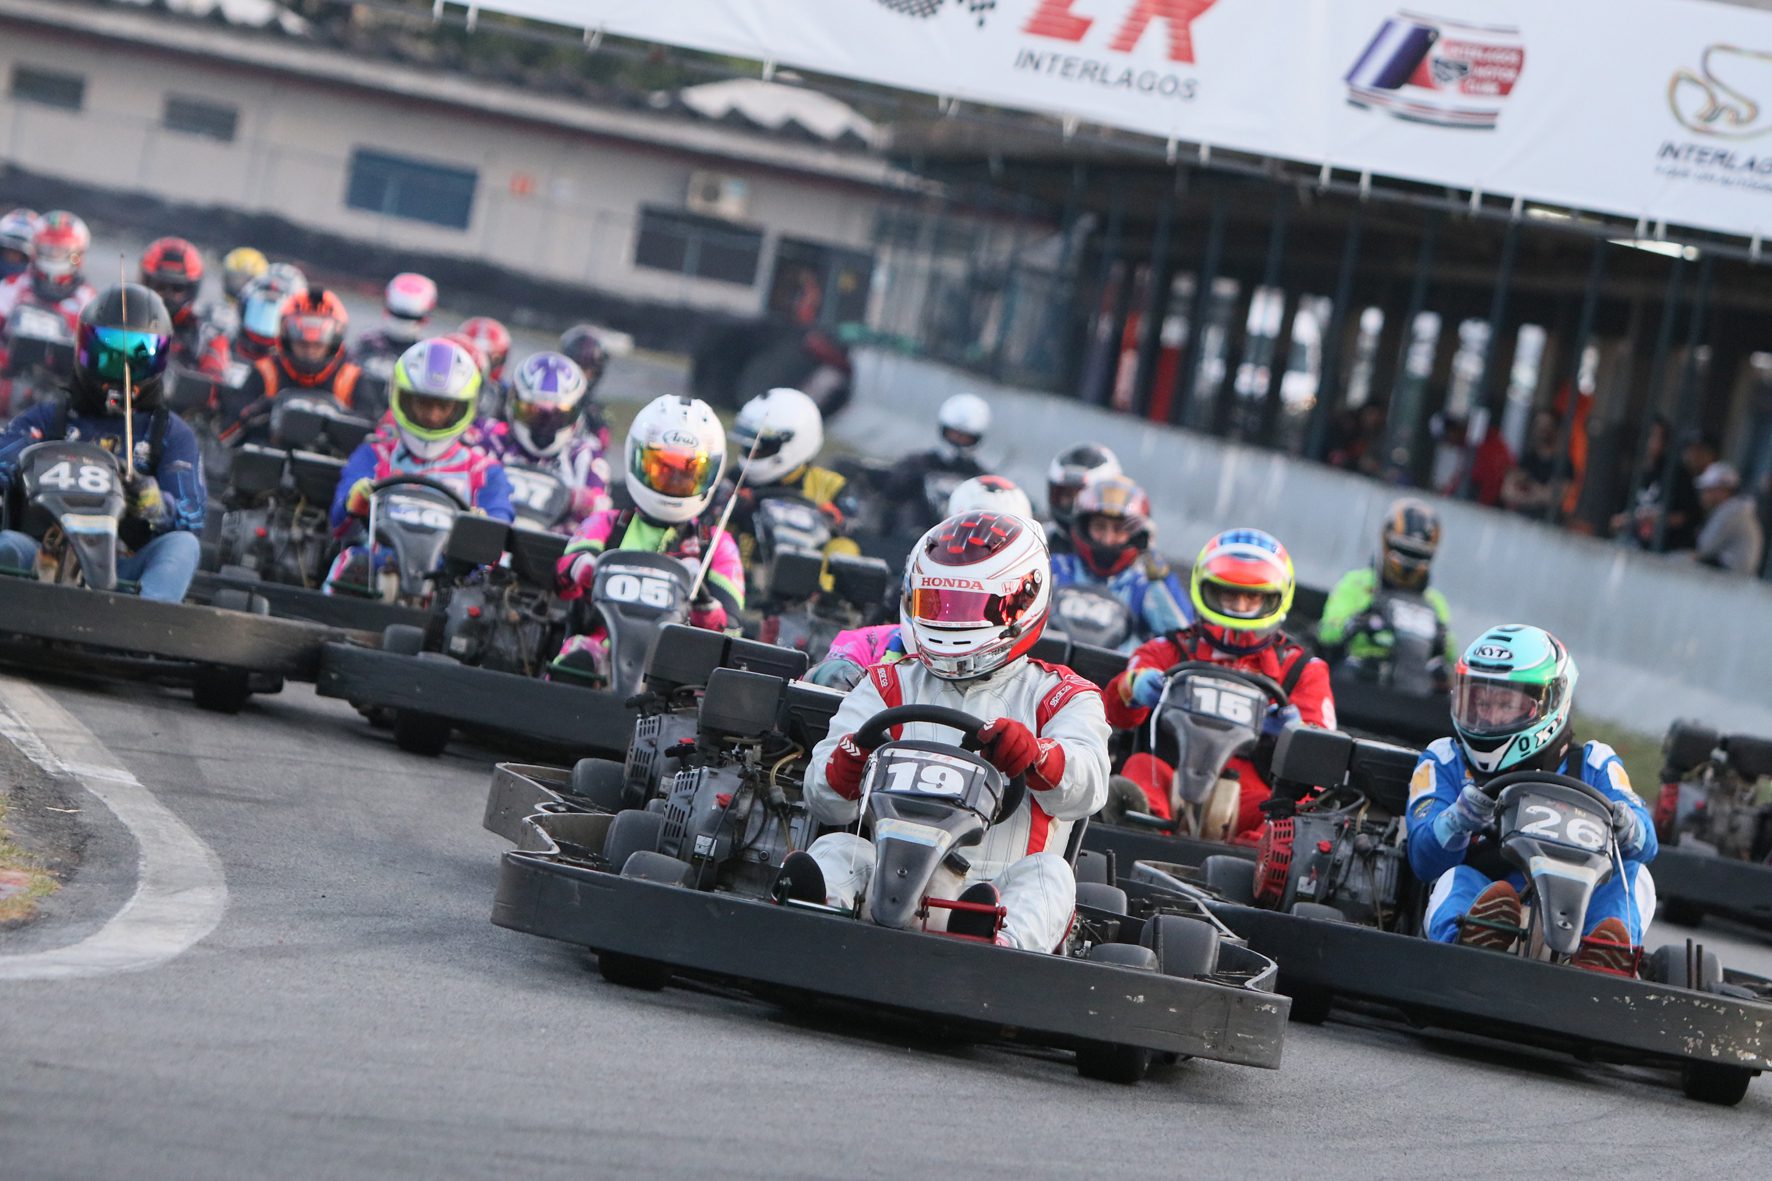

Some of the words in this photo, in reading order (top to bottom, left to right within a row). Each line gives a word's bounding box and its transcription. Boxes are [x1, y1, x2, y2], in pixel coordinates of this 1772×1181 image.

[1014, 49, 1199, 100] INTERLAGOS
[39, 461, 111, 493] 48
[605, 574, 674, 610] 05
[921, 577, 985, 591] HONDA
[1477, 646, 1509, 658] KYT
[1193, 687, 1253, 724] 15
[887, 761, 965, 795] 19
[1520, 805, 1604, 851] 26
